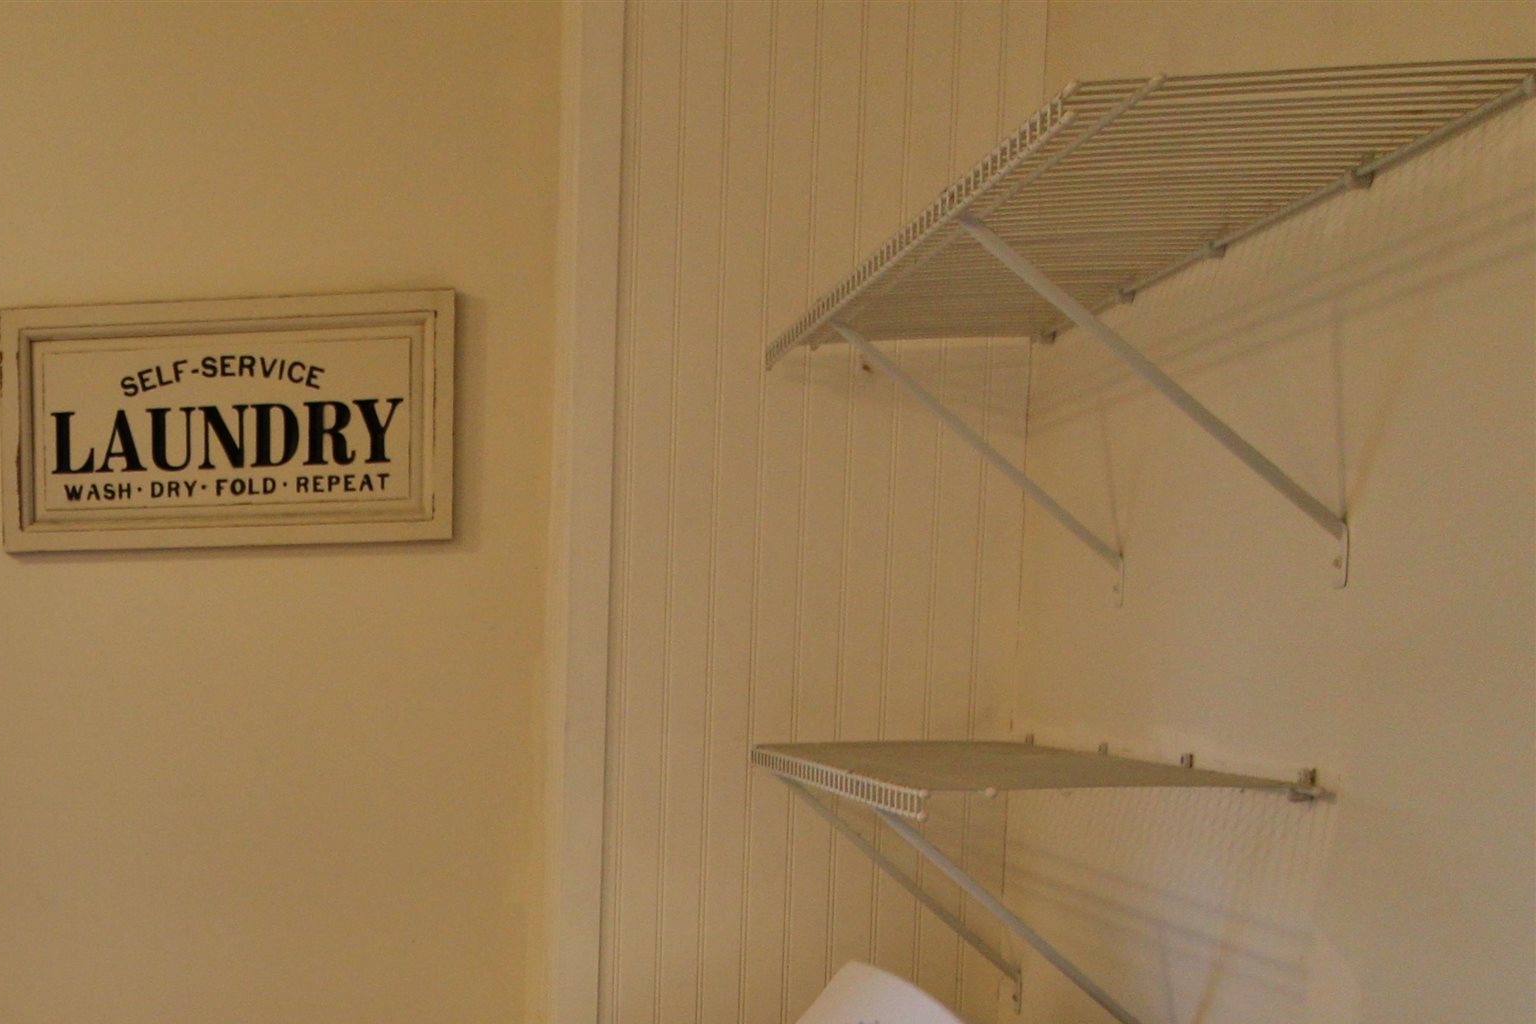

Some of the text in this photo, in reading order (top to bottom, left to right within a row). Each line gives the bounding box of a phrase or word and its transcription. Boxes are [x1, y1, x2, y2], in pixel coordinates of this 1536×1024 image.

[120, 355, 326, 397] SELF-SERVICE
[50, 397, 405, 475] LAUNDRY
[64, 474, 390, 502] WASH DRY FOLD REPEAT
